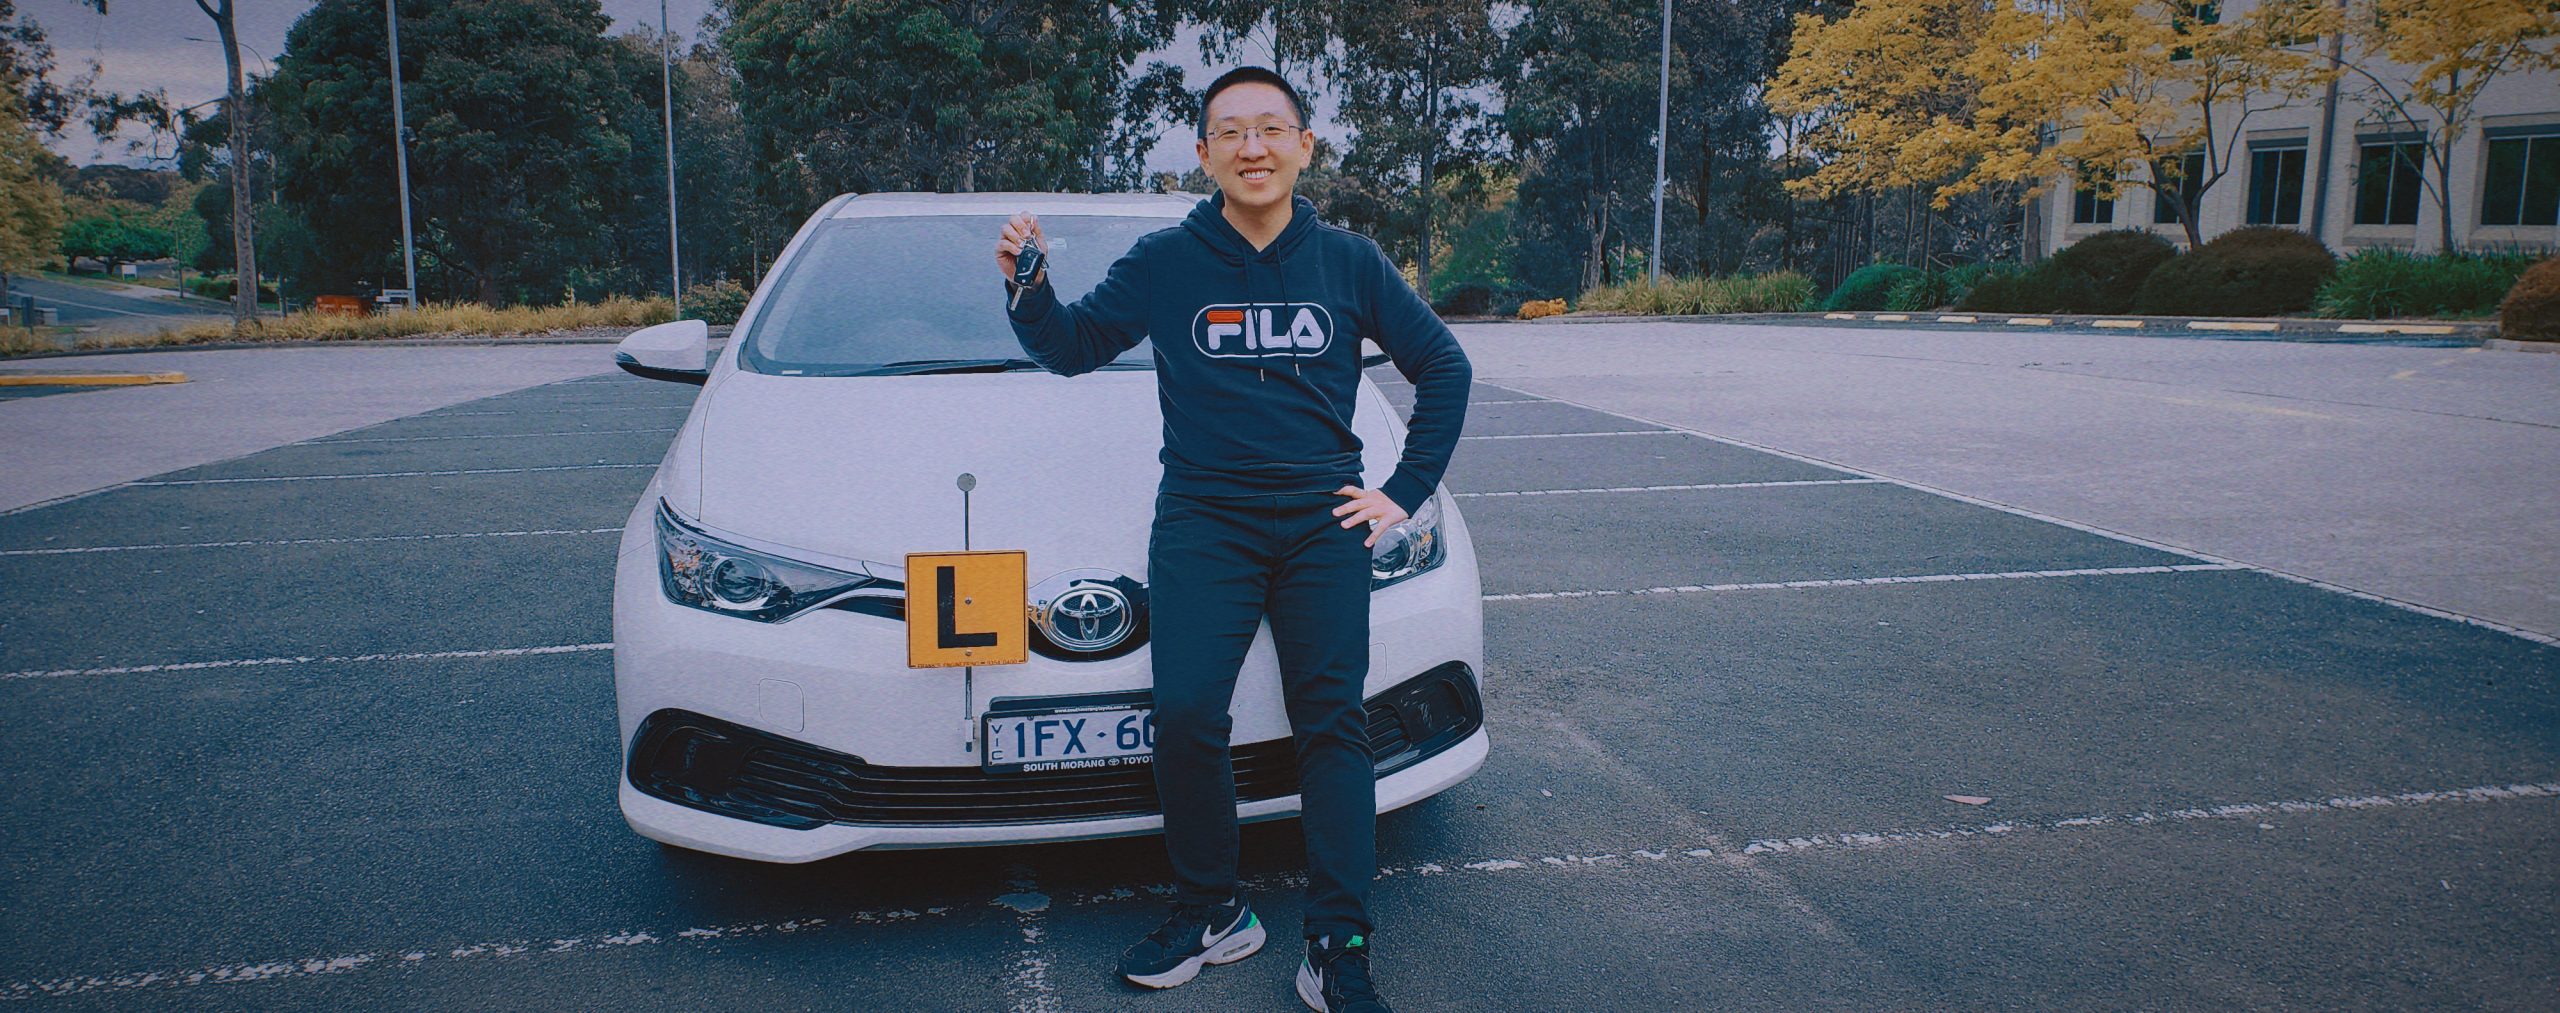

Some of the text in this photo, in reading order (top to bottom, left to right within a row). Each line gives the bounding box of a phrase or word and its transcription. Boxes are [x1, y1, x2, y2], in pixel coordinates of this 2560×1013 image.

[1206, 307, 1325, 350] FILA
[936, 565, 998, 649] L
[1023, 755, 1153, 773] SOUTH MORANG TOYOT
